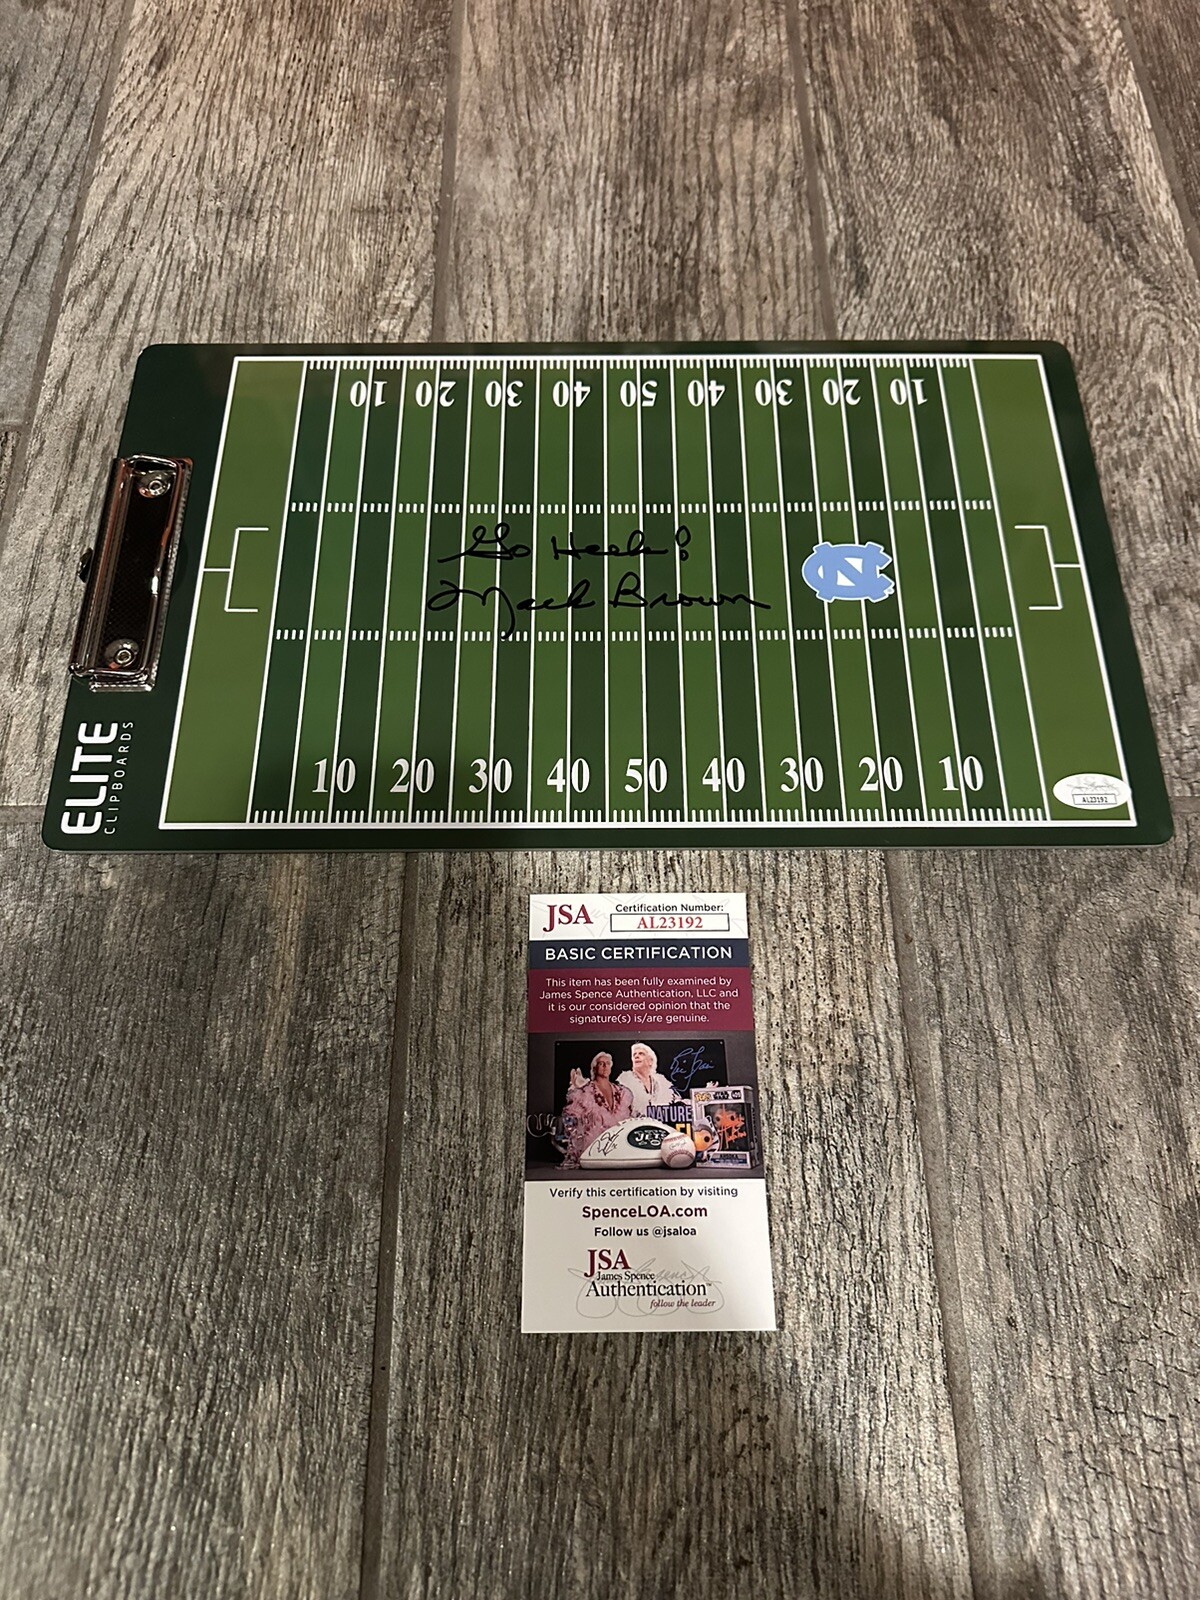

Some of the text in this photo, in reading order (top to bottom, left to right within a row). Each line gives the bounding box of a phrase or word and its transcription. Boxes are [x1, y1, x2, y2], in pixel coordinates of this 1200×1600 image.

[350, 378, 928, 407] 10 20 30 40 50 40 30 20 10
[437, 522, 531, 563] Go
[427, 571, 771, 639] Mack Brown
[60, 722, 119, 834] ELITE
[104, 721, 134, 835] CLIPBOARDS
[311, 756, 984, 793] 10 20 30 40 50 40 30 20 10
[615, 903, 724, 912] Certification Number:
[543, 904, 594, 932] JSA
[637, 916, 703, 929] AL23192
[545, 946, 732, 961] BASIC CERTIFICATION
[546, 977, 732, 988] This item has been fully examined by
[540, 989, 739, 1001] James Spence Authentication, LLC and
[548, 1003, 555, 1011] it
[558, 1003, 566, 1011] is
[589, 1002, 645, 1011] considered
[648, 1002, 687, 1012] opinion
[690, 1001, 710, 1010] that
[713, 1001, 731, 1010] the
[569, 1014, 710, 1025] signature(s) is/are genuine.
[647, 1105, 692, 1122] NATURE
[550, 1186, 738, 1199] Verify this certification by visiting
[582, 1205, 708, 1220] SpenceLOA.com
[594, 1227, 633, 1237] Follow
[652, 1227, 697, 1237] @jsaloa
[584, 1248, 632, 1277] JSA
[597, 1271, 655, 1282] James Spence
[650, 1299, 716, 1309] follow the leader
